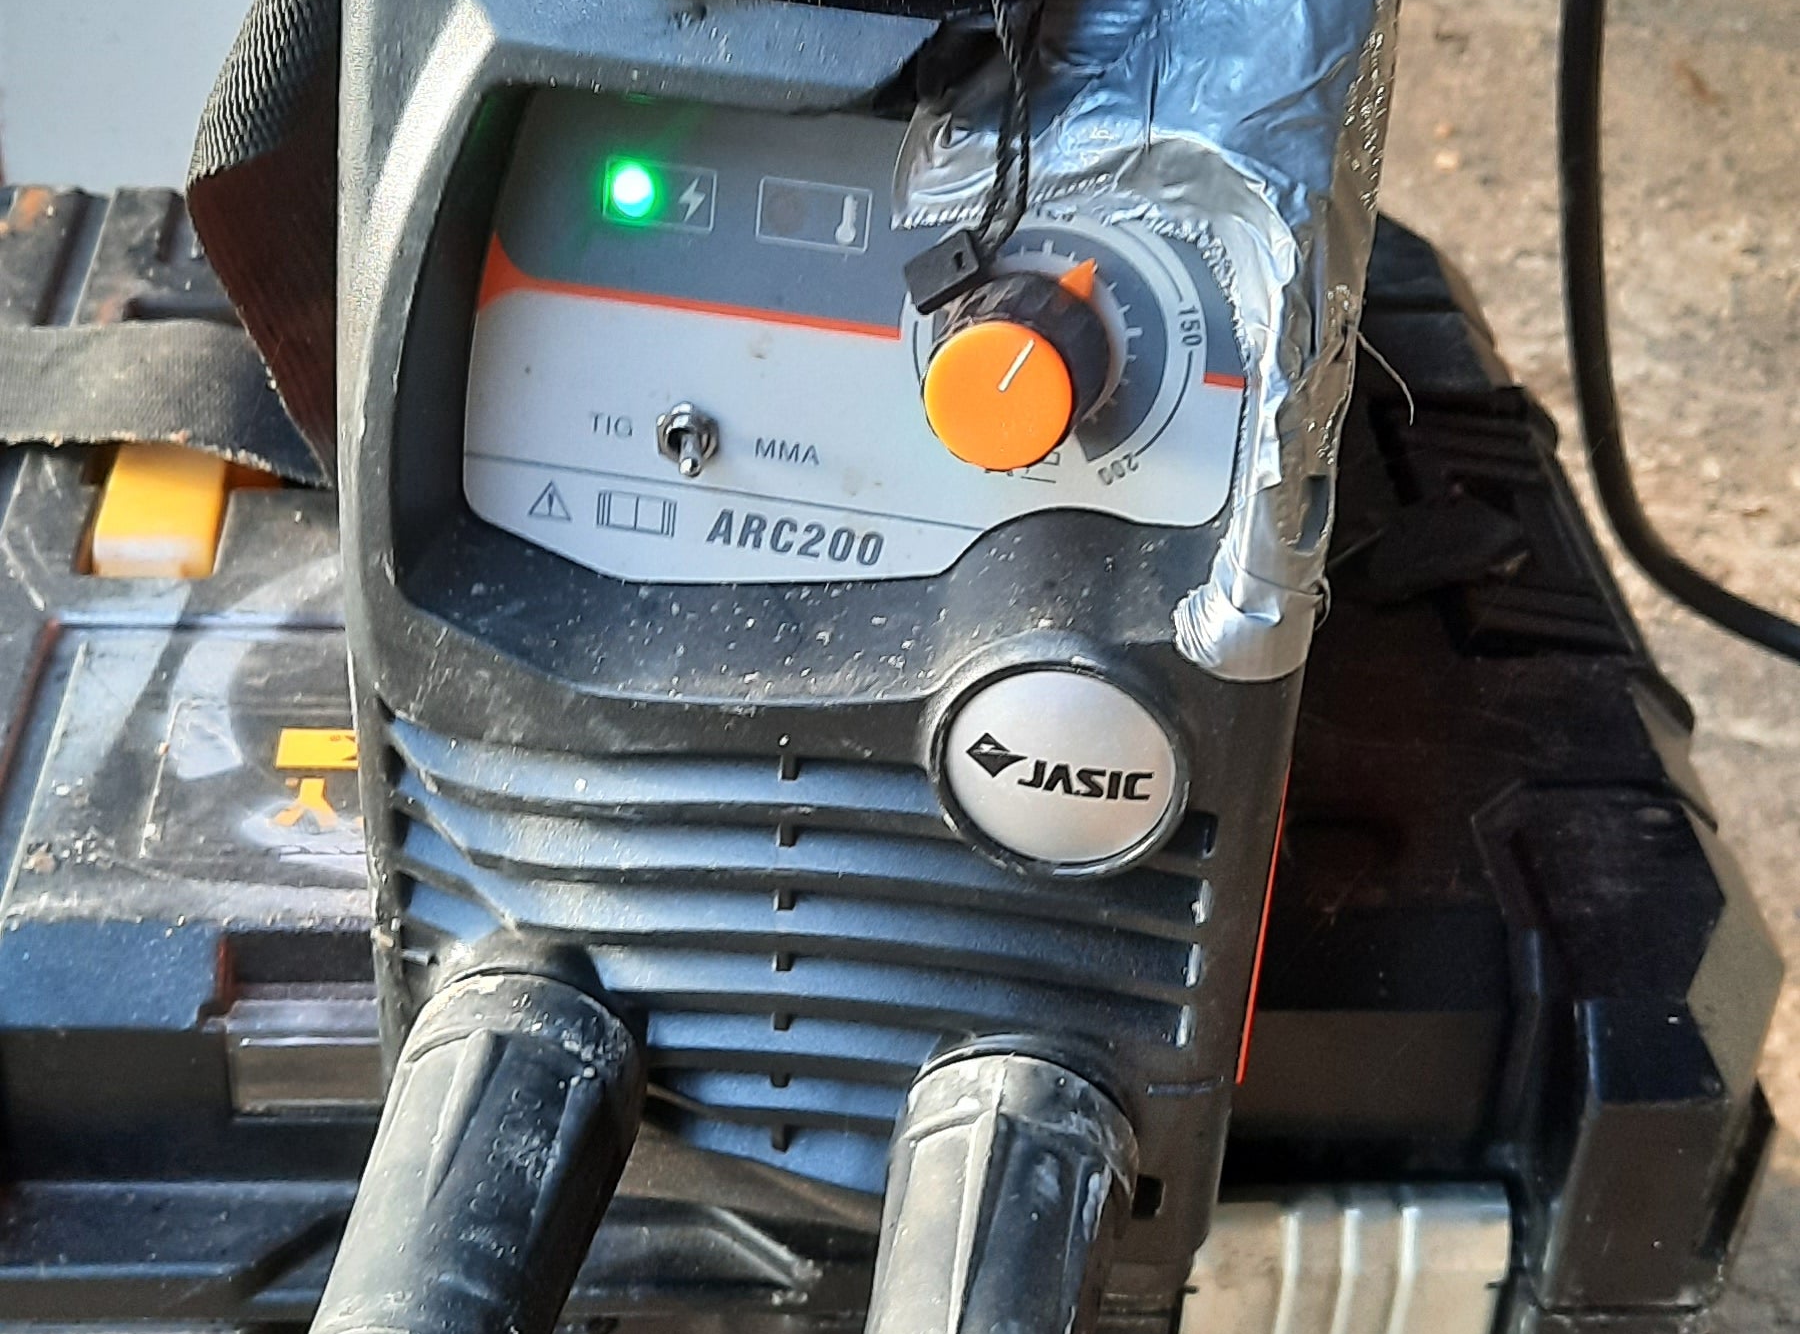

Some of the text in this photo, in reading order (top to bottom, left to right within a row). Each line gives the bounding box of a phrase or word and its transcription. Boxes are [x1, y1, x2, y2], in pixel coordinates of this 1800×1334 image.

[1178, 304, 1203, 347] 150
[589, 411, 633, 438] TIG
[754, 437, 820, 466] MMA
[1097, 454, 1140, 486] 200
[706, 508, 885, 567] ARC200
[1016, 759, 1156, 801] JASIC
